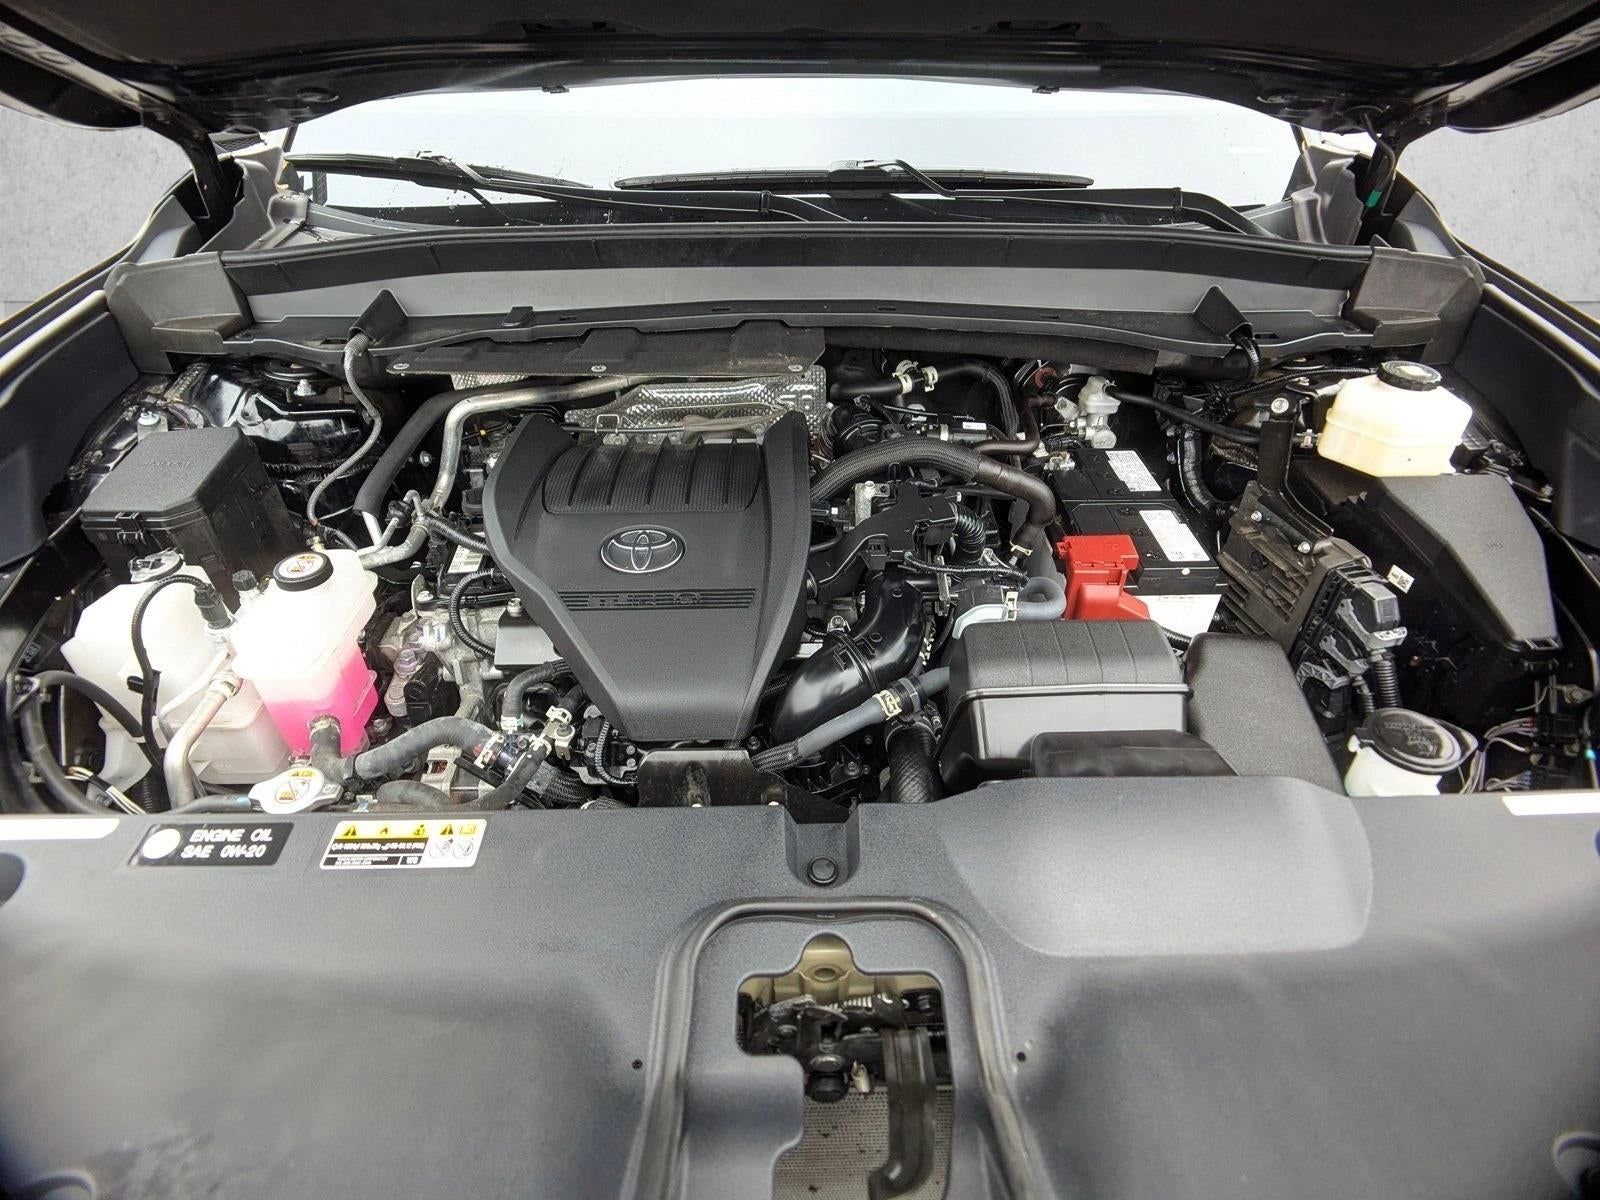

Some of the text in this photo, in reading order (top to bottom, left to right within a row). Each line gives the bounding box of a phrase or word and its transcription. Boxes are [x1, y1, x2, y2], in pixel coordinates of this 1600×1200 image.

[189, 828, 273, 843] ENGINE OIL
[180, 844, 267, 859] SAE 0W-20
